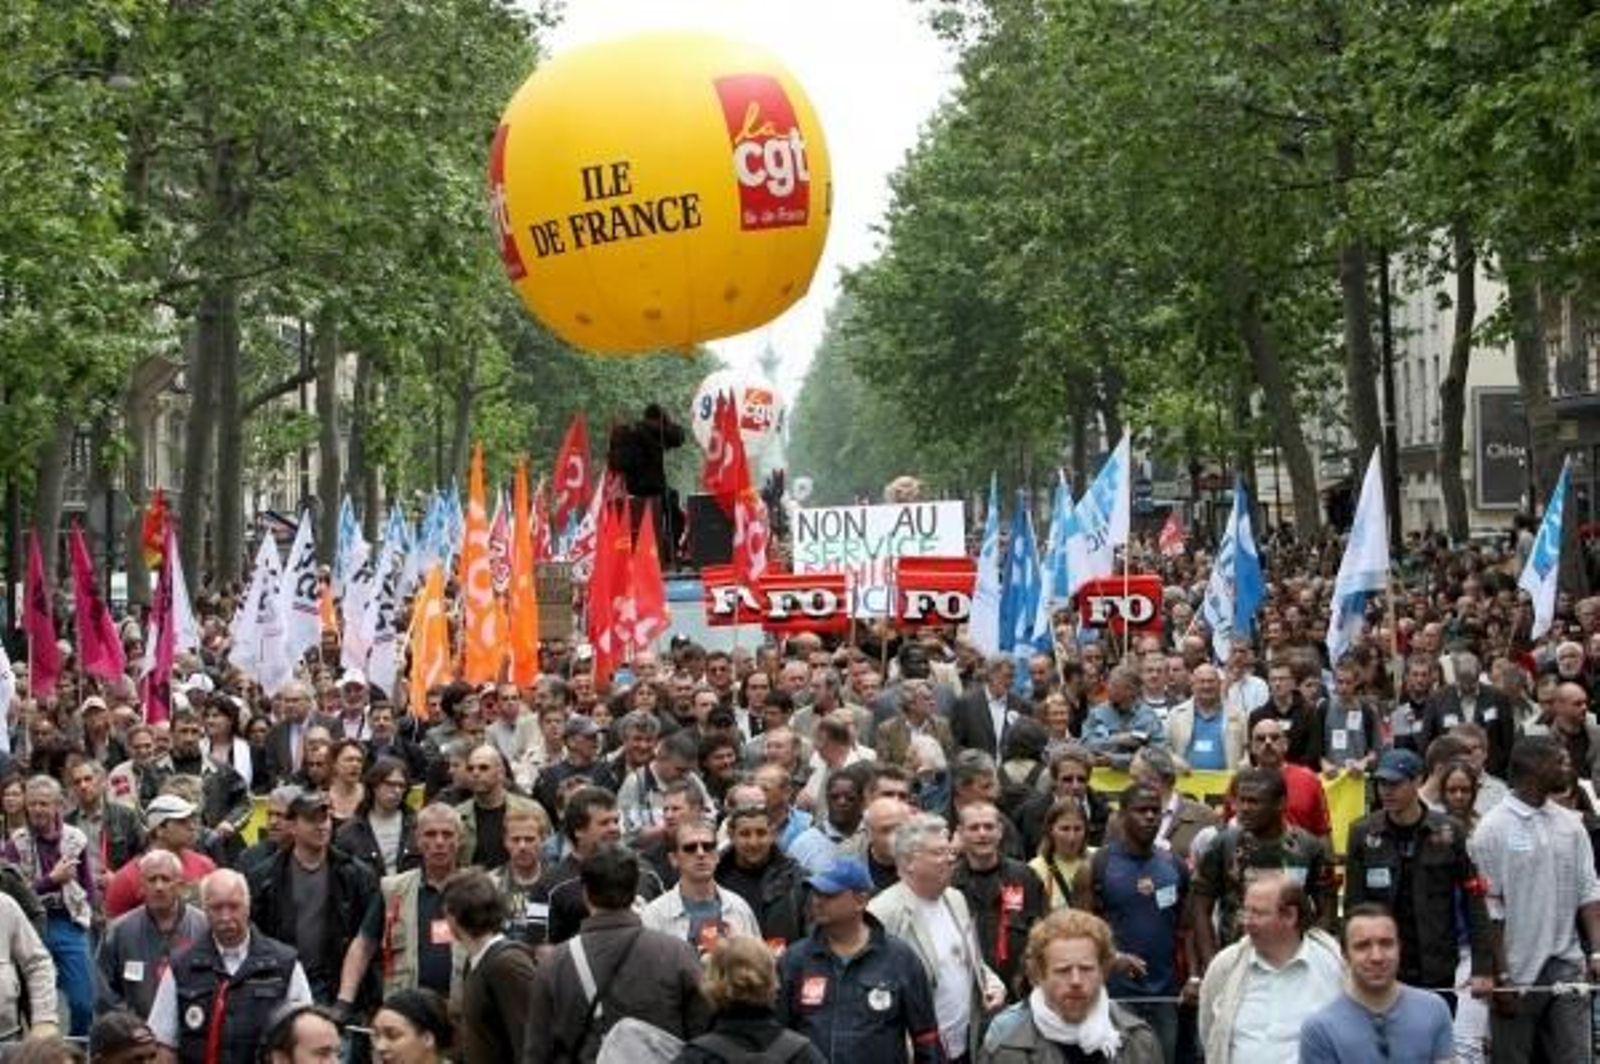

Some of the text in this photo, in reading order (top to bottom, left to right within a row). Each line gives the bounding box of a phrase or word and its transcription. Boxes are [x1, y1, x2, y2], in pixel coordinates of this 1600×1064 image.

[734, 126, 809, 198] cgt
[580, 161, 633, 202] ILE
[529, 217, 566, 258] DE
[568, 193, 702, 250] FRANCE
[798, 508, 867, 542] NON
[891, 504, 938, 538] AU
[802, 533, 940, 565] SERVICE
[767, 588, 838, 619] FO
[902, 590, 972, 620] FO
[1085, 593, 1156, 623] FO
